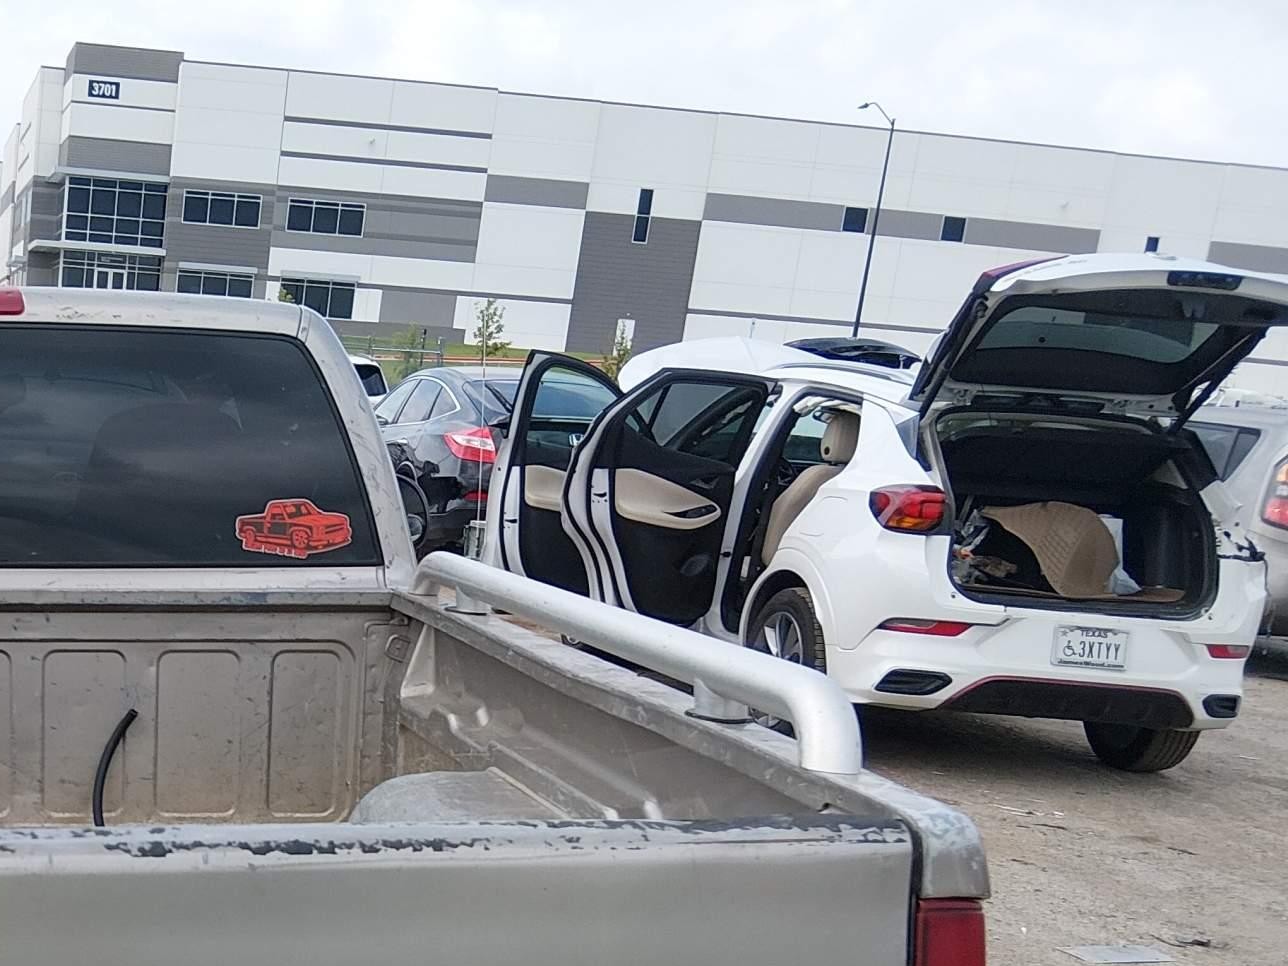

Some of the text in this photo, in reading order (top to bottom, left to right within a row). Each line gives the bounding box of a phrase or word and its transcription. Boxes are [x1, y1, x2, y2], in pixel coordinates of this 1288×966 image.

[91, 82, 116, 97] 3701
[1080, 629, 1109, 639] TEXAS
[1078, 640, 1121, 661] 3XTYY
